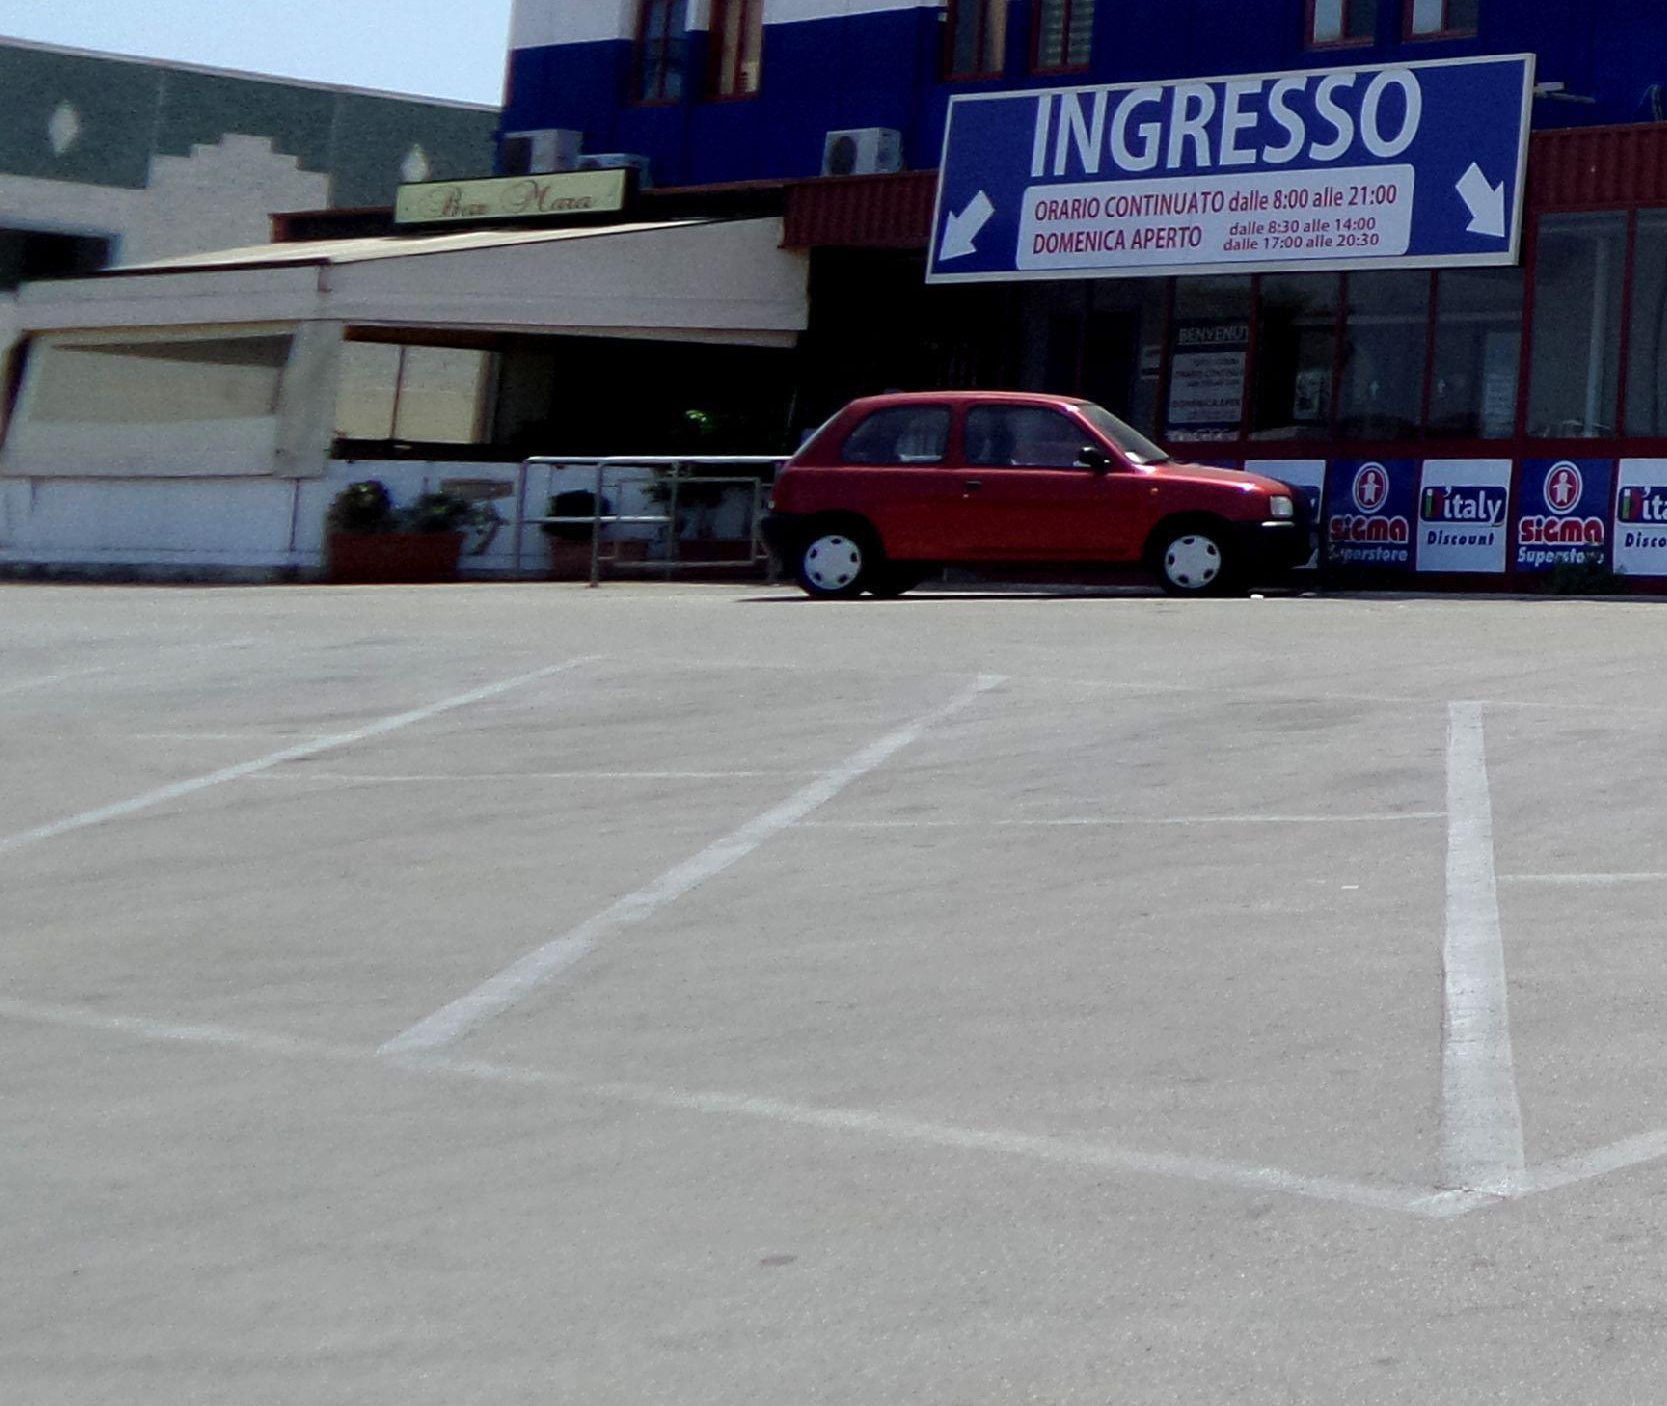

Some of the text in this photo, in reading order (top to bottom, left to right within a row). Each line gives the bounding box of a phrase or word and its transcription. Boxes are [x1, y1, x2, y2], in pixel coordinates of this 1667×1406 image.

[1031, 67, 1423, 178] INGRESSO
[1035, 184, 1398, 221] ORARIO CONTINUATO dalle 8:00 alle 21:00
[1229, 217, 1376, 236] dalle 8:30 alle 14:00
[1033, 225, 1202, 254] DOMENICA APERTO
[1223, 233, 1380, 252] dalle 17:00 alle 20:30
[1427, 530, 1495, 546] Discount
